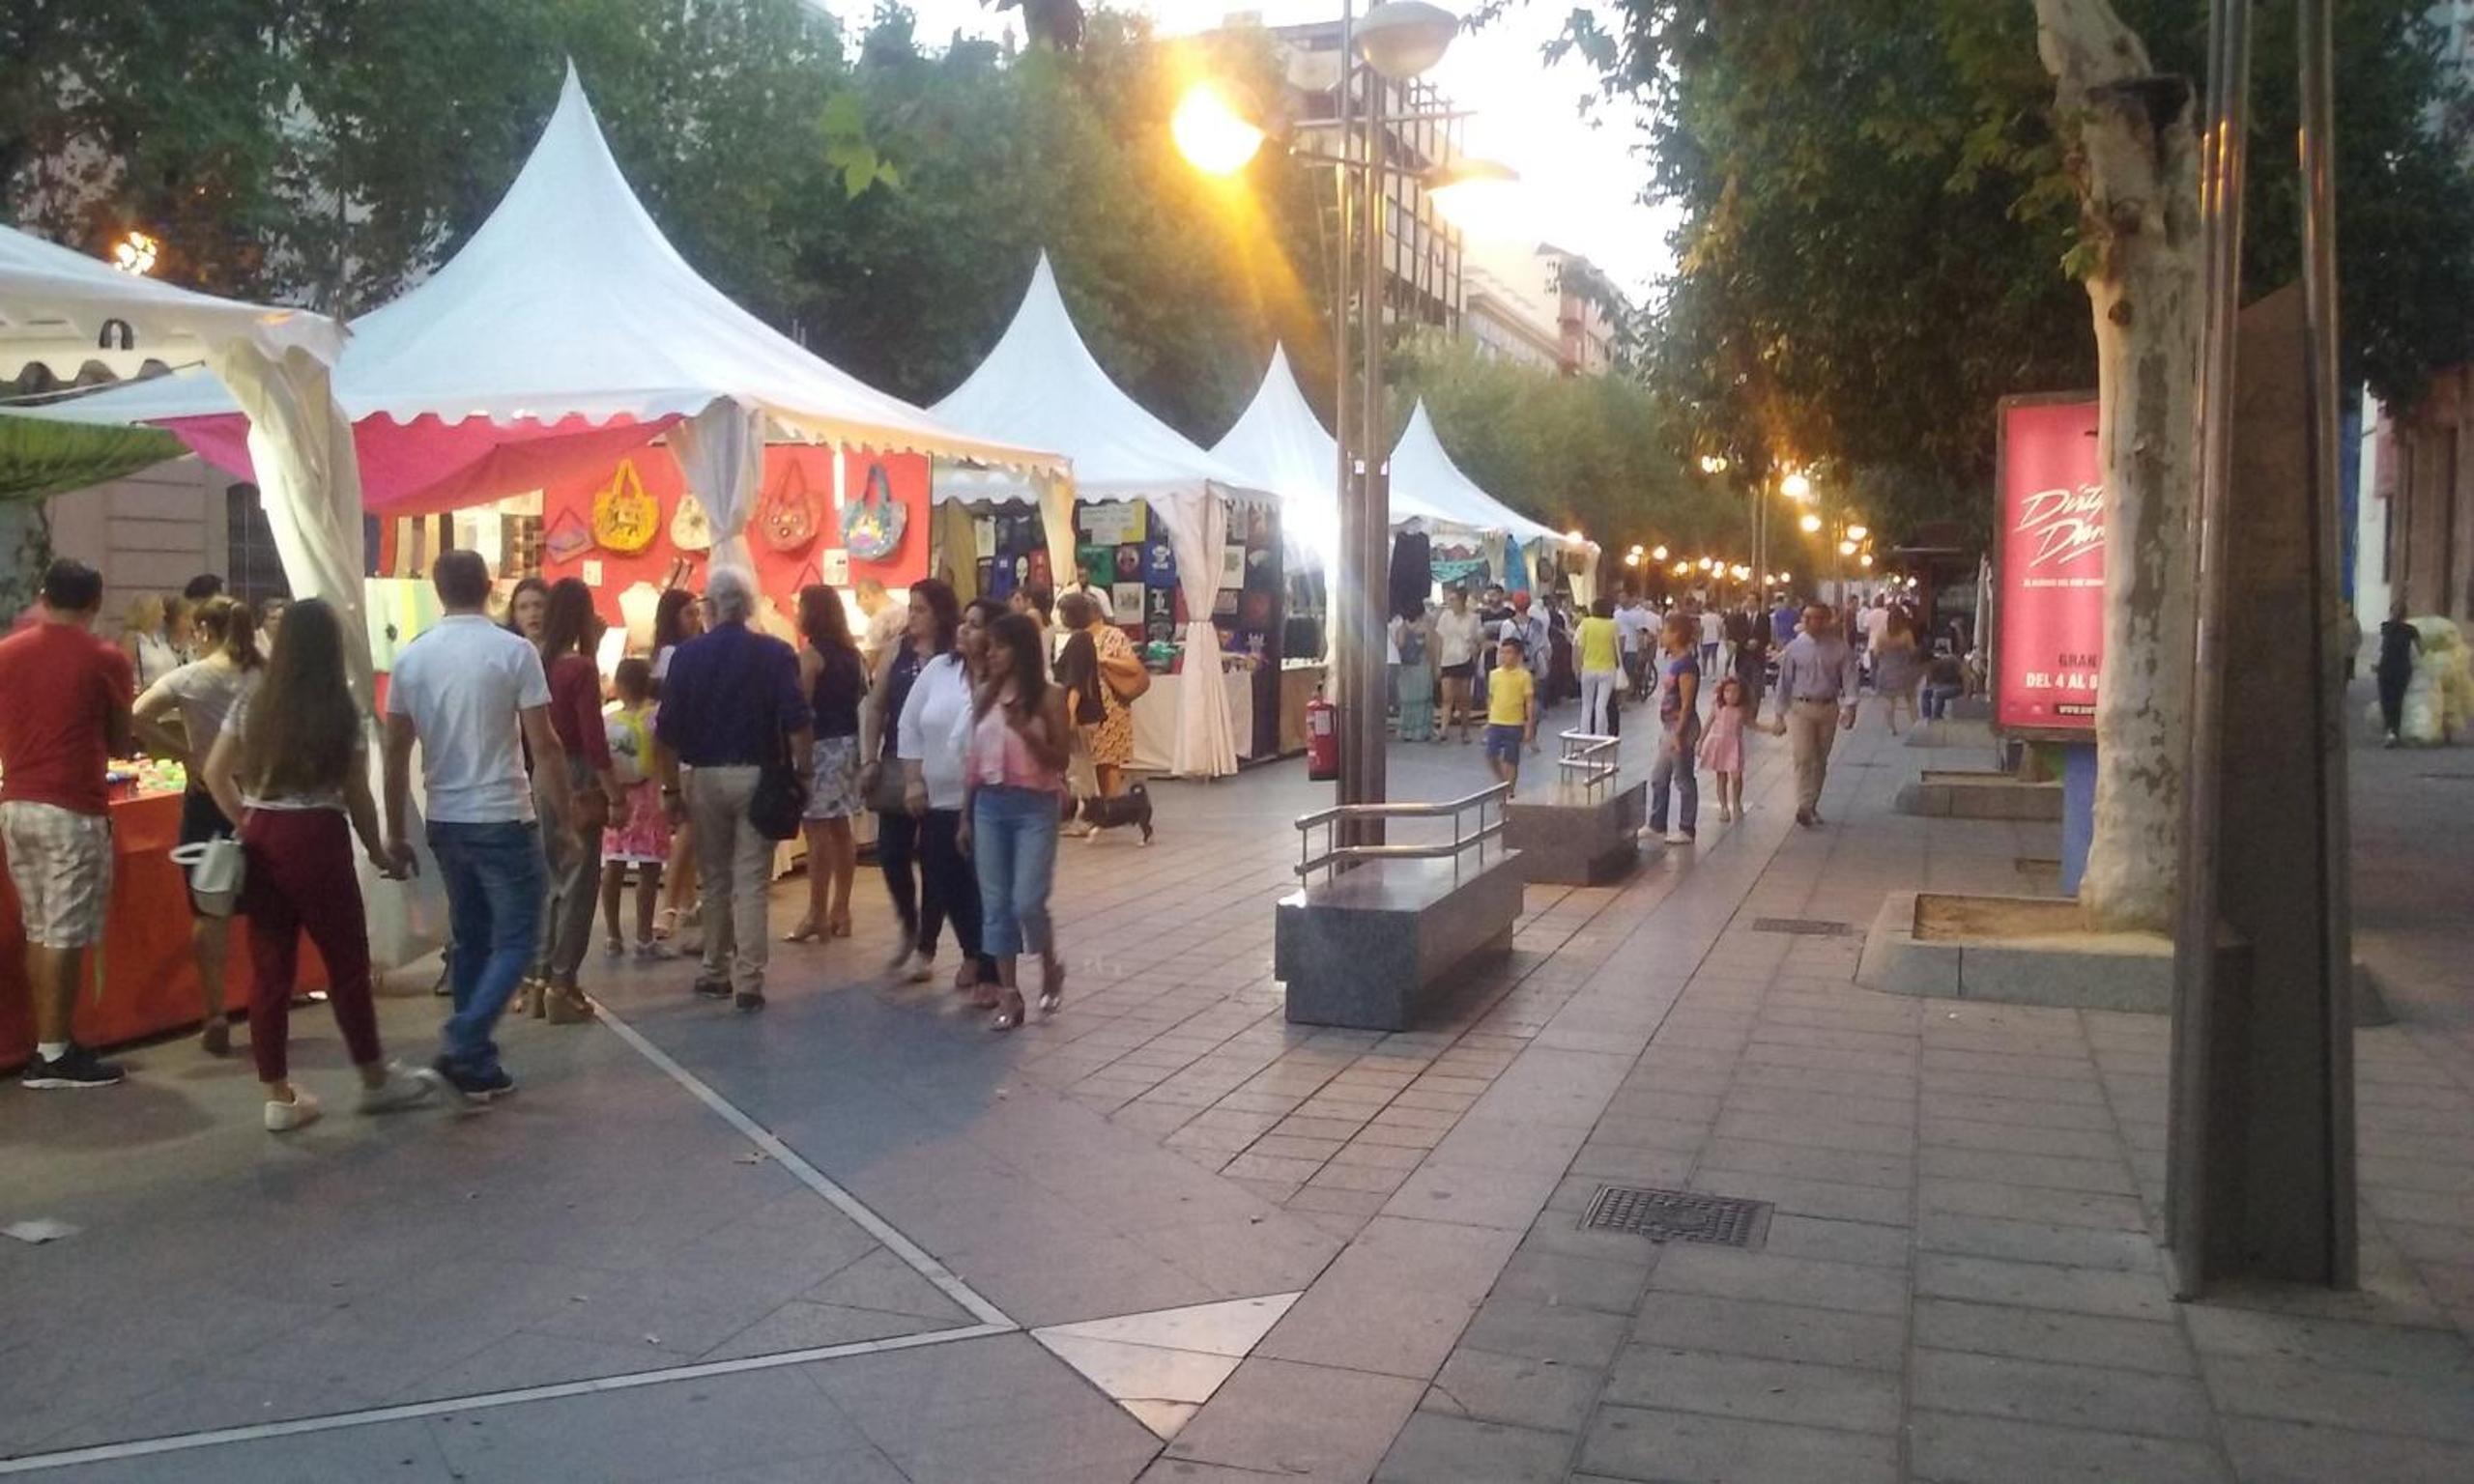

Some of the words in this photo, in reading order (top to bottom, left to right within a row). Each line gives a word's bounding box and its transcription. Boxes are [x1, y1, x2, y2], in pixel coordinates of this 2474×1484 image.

[2026, 671, 2051, 688] DEL
[2055, 672, 2064, 688] 4
[2067, 672, 2086, 689] AL
